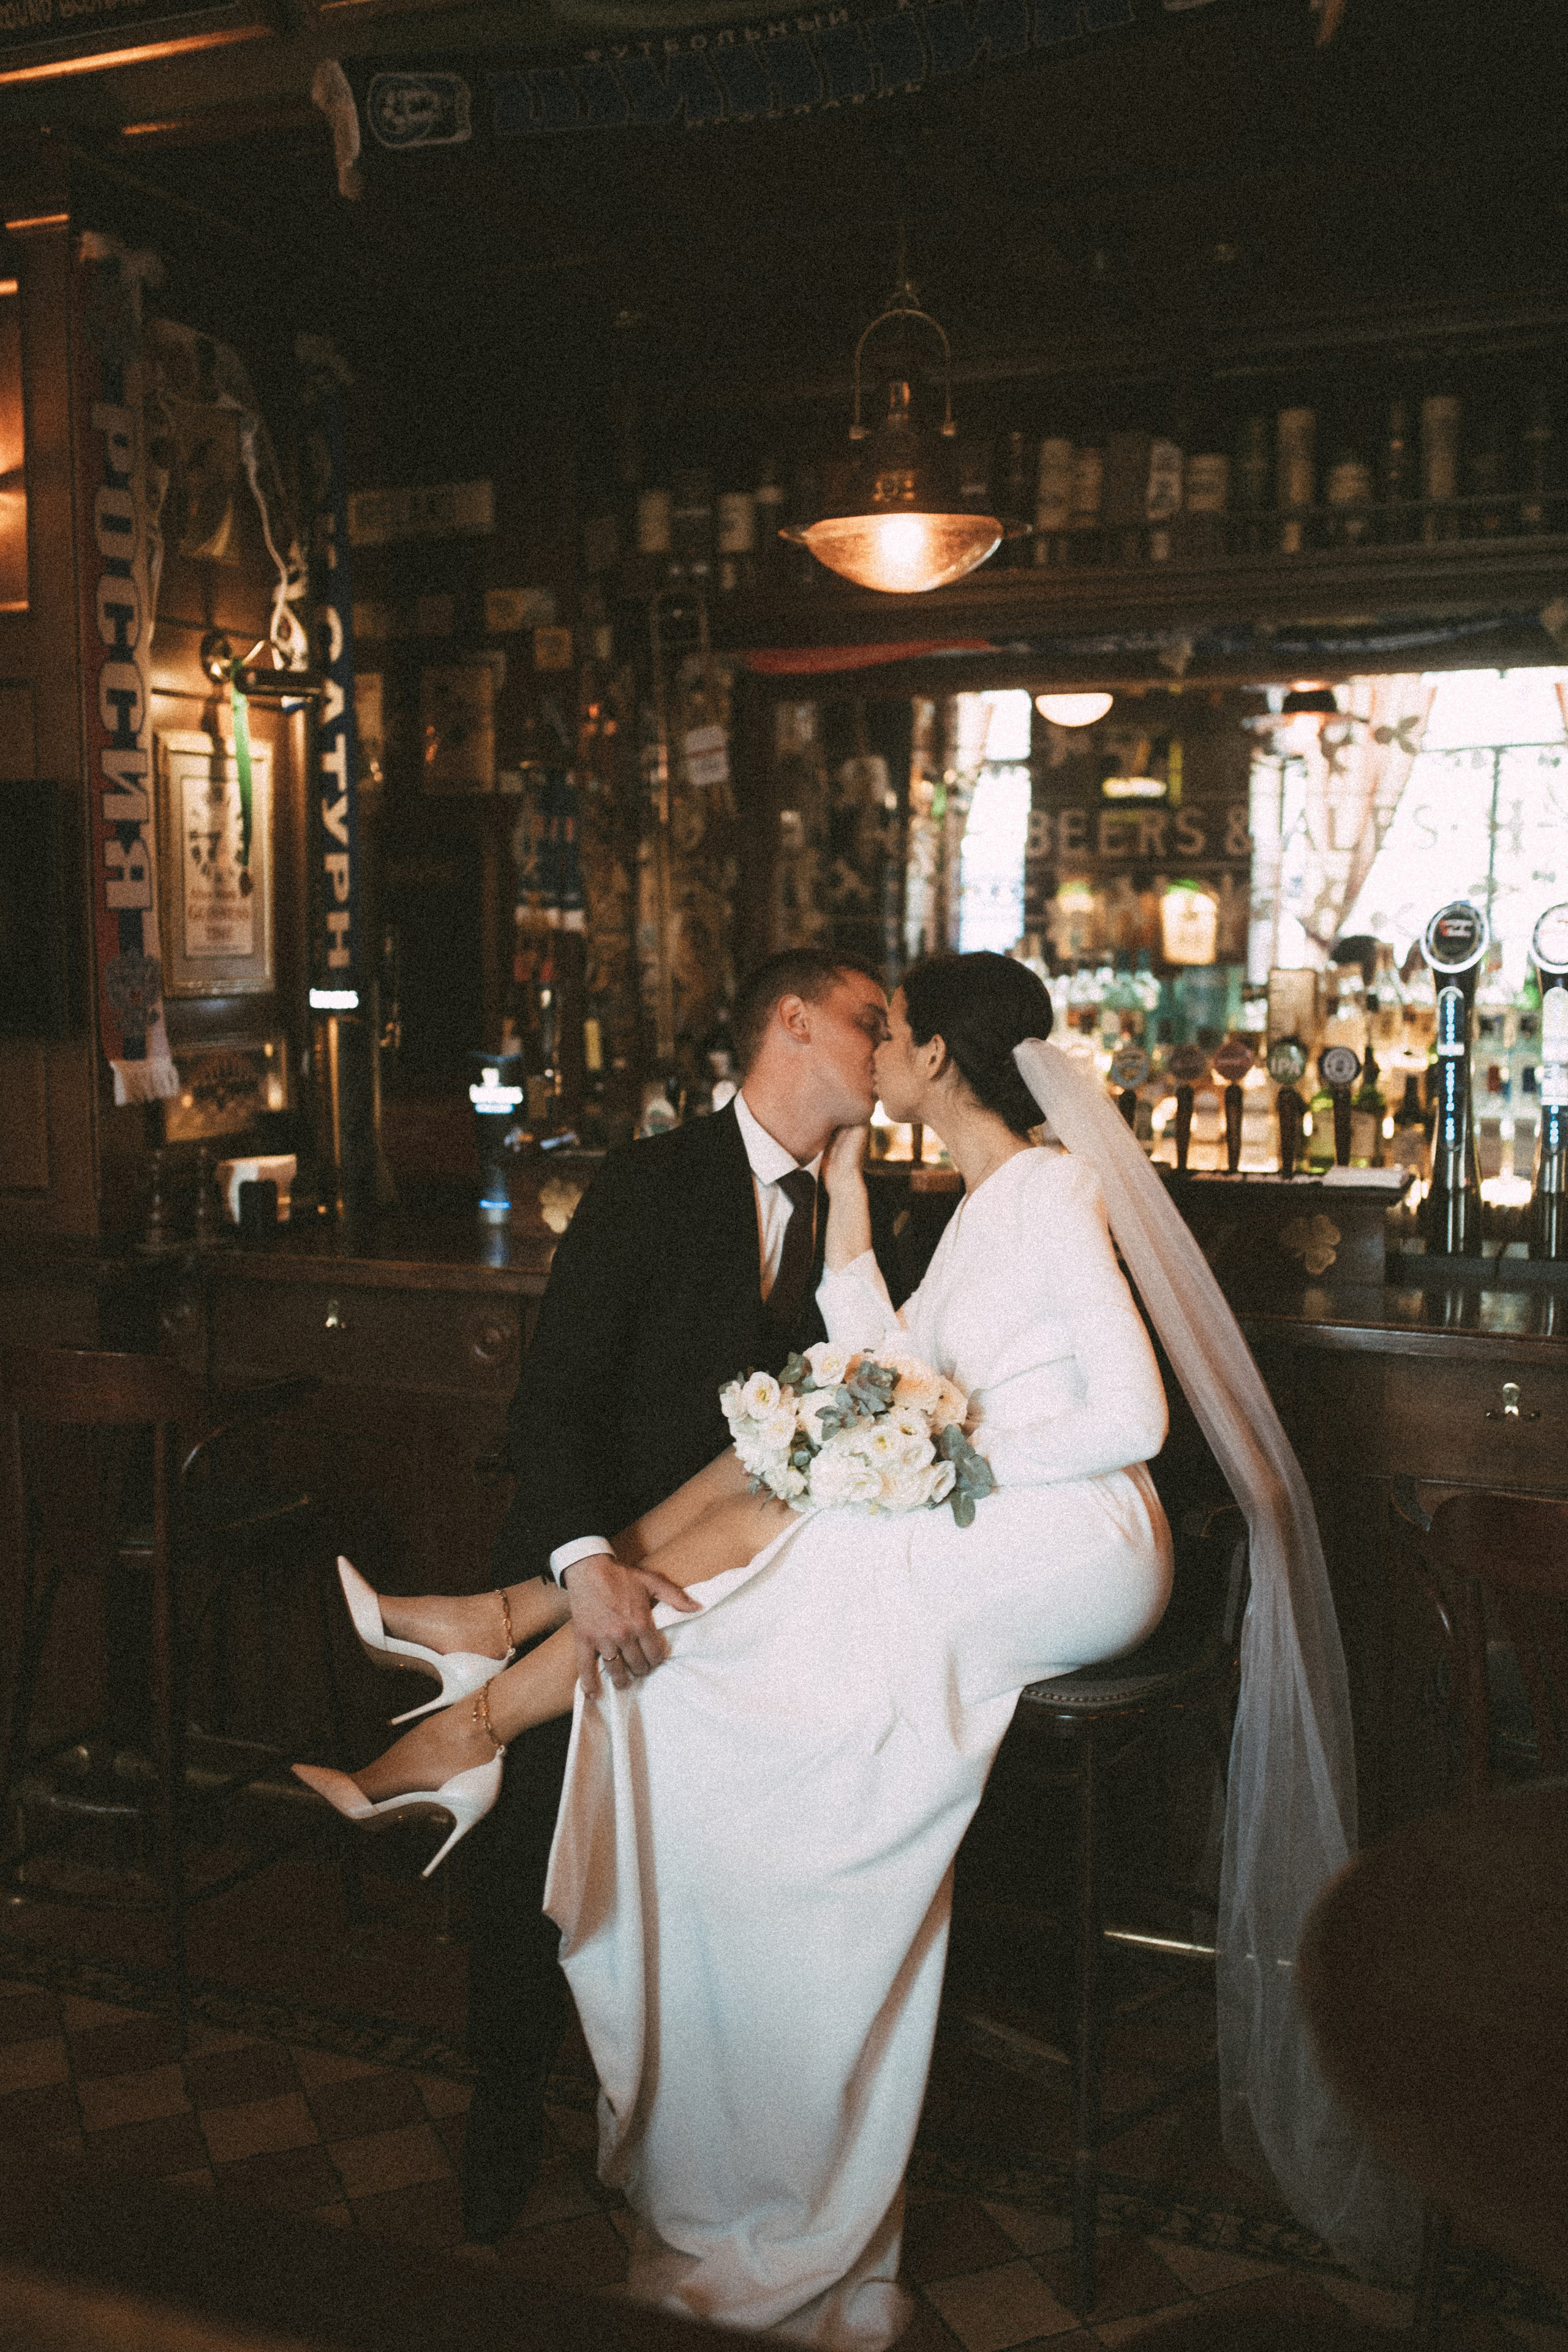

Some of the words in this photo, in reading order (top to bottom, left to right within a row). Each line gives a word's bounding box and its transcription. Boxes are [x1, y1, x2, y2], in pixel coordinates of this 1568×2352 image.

[92, 401, 153, 911] РОССИЯ
[315, 604, 352, 970] САТУРН
[1025, 807, 1206, 856] BEERS
[1270, 1057, 1302, 1076] IPA
